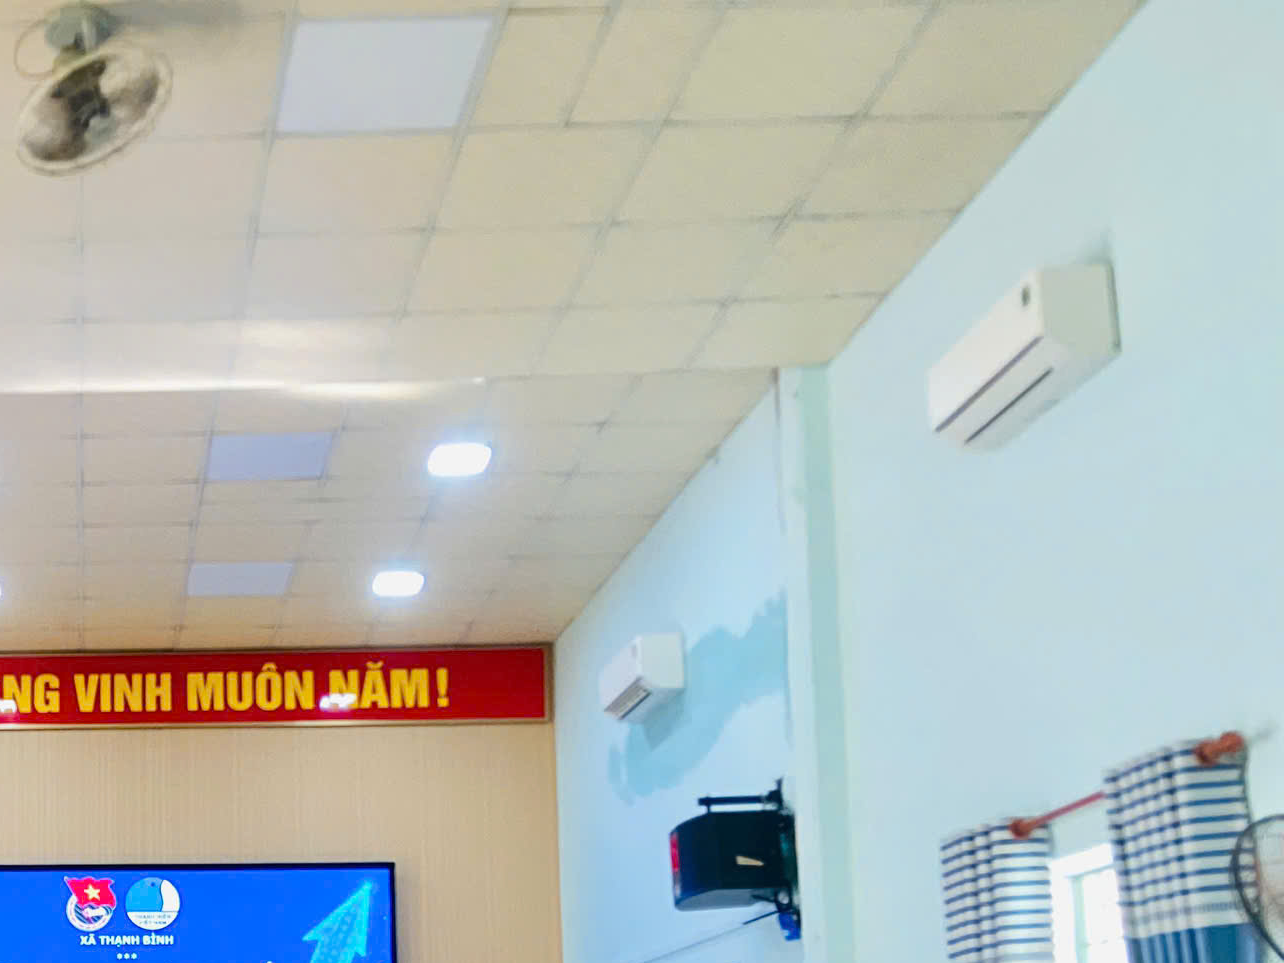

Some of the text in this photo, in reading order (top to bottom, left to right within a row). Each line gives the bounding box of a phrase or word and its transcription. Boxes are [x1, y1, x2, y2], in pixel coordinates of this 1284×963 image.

[73, 672, 172, 713] VINH
[186, 662, 314, 712] MUÔN
[80, 932, 174, 948] XÃ THẠNH BÌNH
